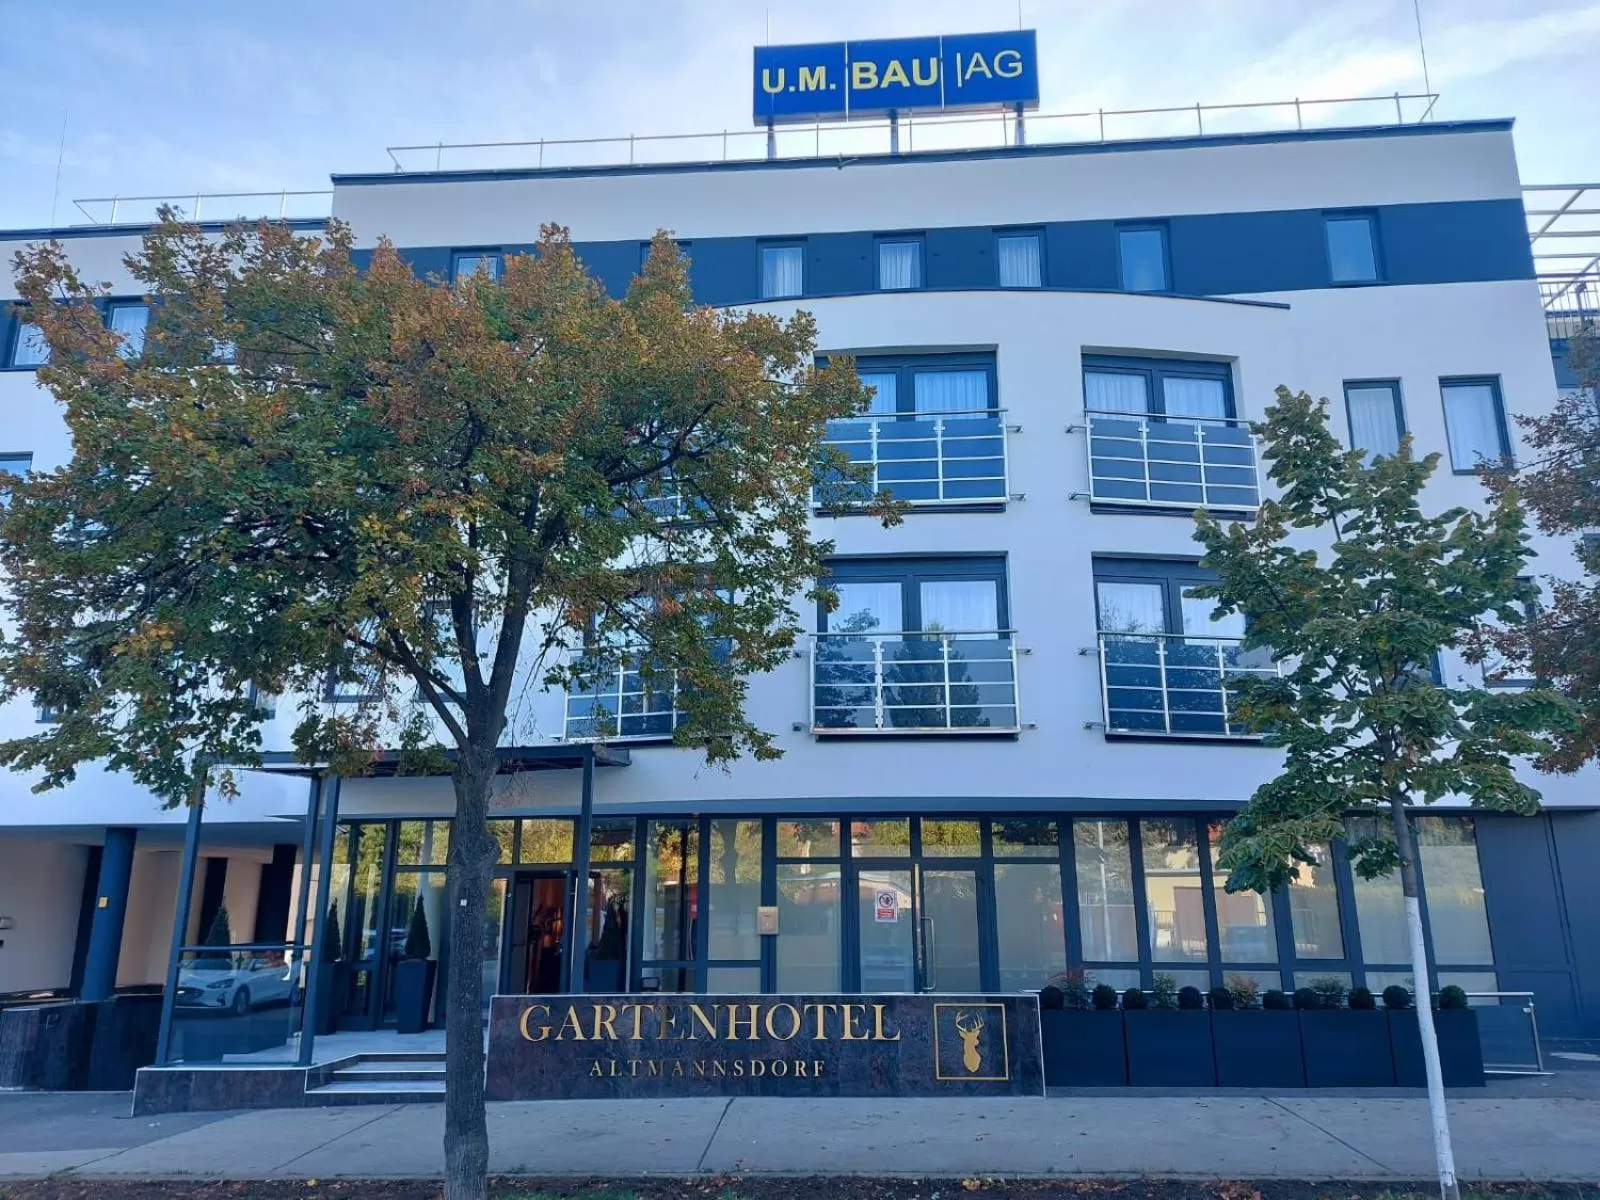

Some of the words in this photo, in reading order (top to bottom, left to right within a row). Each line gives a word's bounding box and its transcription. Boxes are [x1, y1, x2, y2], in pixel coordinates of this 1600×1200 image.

[762, 66, 837, 93] U.M.
[852, 57, 939, 90] BAU
[519, 1003, 901, 1042] GARTENHOTEL
[588, 1059, 826, 1077] ALTMANNSDORF
